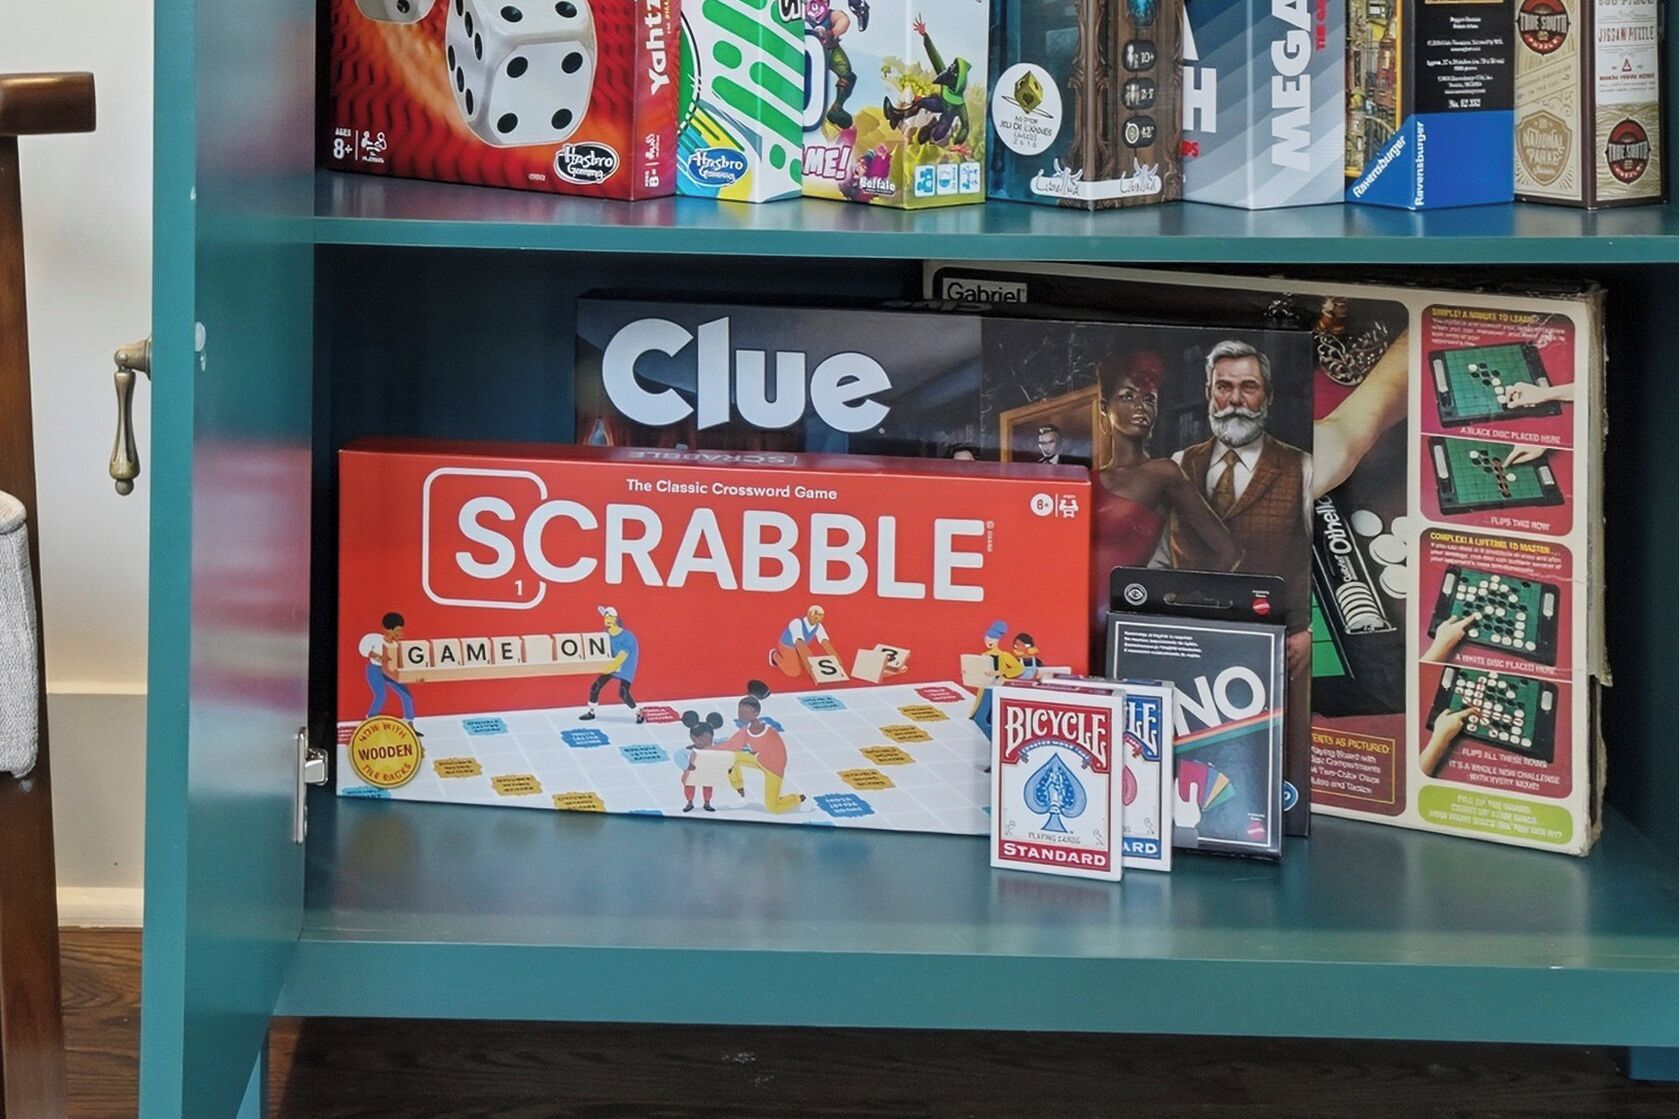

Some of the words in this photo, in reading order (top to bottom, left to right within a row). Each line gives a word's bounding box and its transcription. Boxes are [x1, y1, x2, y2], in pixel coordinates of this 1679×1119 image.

[333, 138, 353, 159] 8+
[562, 144, 614, 168] Hasbro
[689, 150, 744, 171] Hasbro
[803, 145, 852, 180] ME!
[1352, 135, 1406, 198] Ravensburger
[1408, 121, 1426, 210] Ravensburger
[948, 282, 1020, 303] Gabriel
[602, 317, 893, 432] Clue
[1511, 432, 1539, 442] PLACED
[627, 479, 652, 492] The
[656, 480, 708, 495] Classic
[712, 482, 790, 498] Crossword
[794, 486, 837, 500] Game
[456, 496, 985, 601] SCRABBLE
[514, 579, 523, 596] 1
[408, 641, 514, 665] GAME
[561, 637, 606, 658] ON
[818, 659, 838, 676] S
[1173, 666, 1266, 737] NO
[360, 723, 380, 742] NOW
[383, 722, 406, 739] WITH
[1005, 706, 1106, 768] BICYCLE
[1312, 733, 1334, 745] ENTS
[1335, 737, 1346, 747] AS
[358, 743, 412, 760] WOODEN
[362, 764, 380, 780] TILE
[1003, 842, 1106, 866] STANDARD
